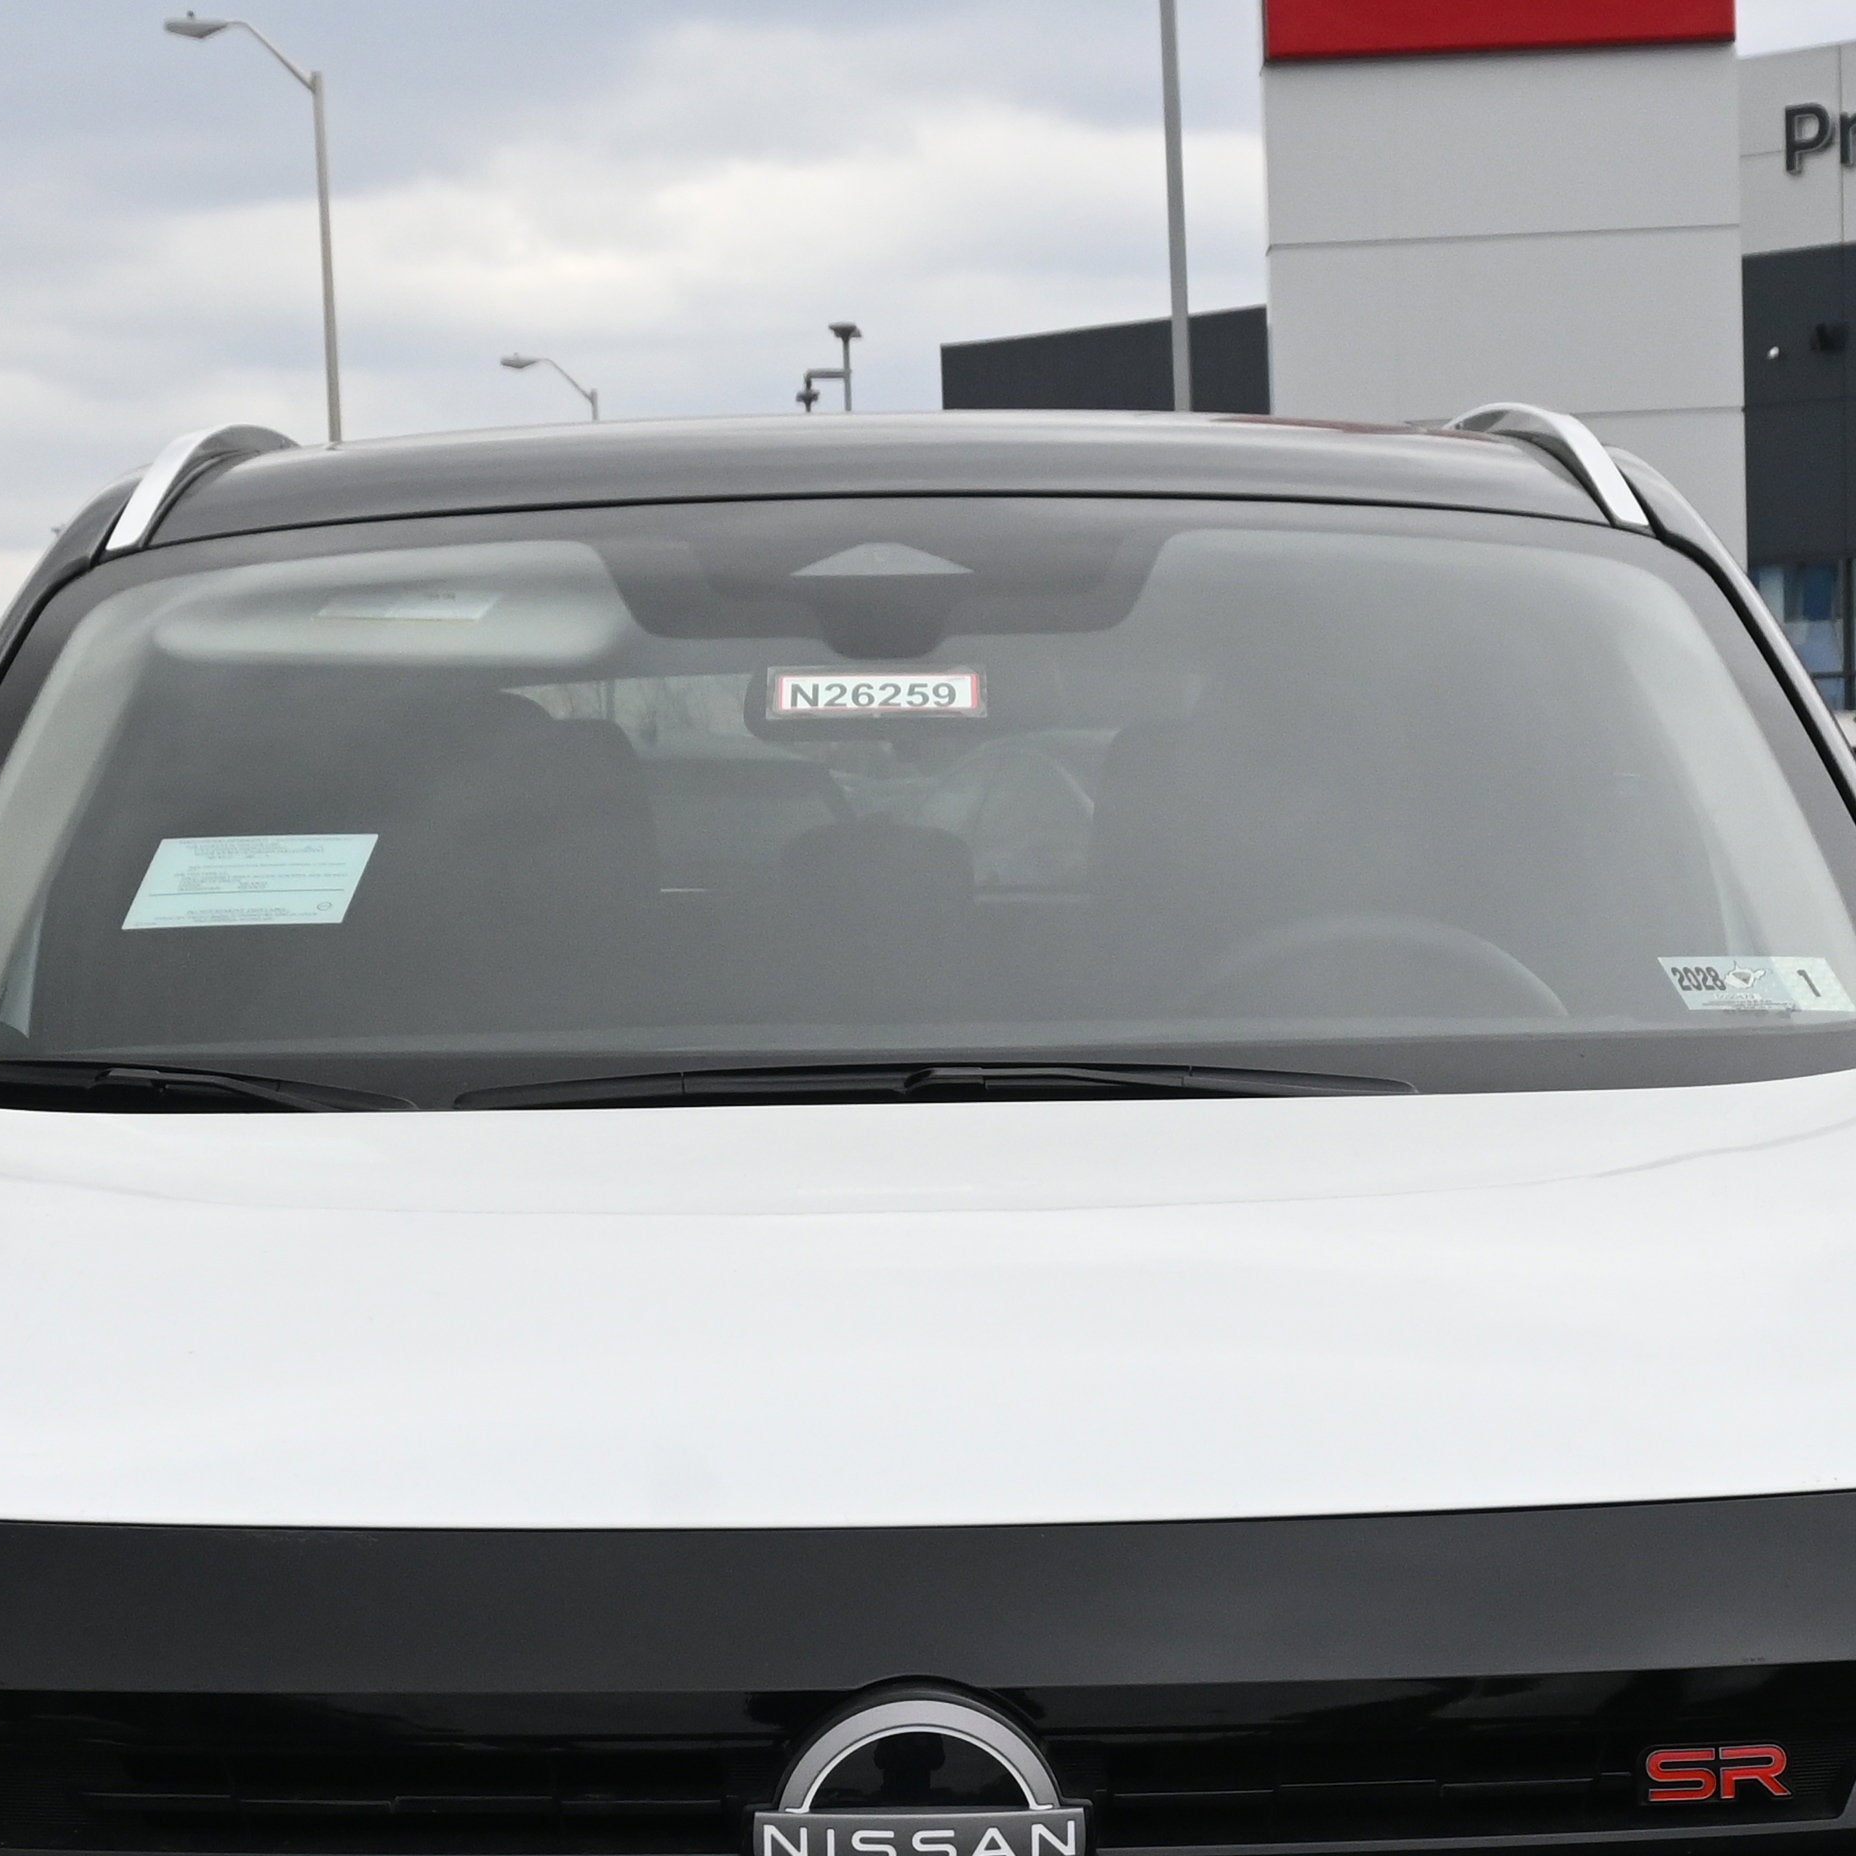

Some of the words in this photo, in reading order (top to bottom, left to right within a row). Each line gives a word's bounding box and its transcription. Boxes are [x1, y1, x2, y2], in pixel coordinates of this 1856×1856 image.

[790, 683, 957, 708] N26259
[1670, 966, 1727, 992] 2028
[1796, 968, 1822, 998] 1
[1645, 1743, 1793, 1803] SR
